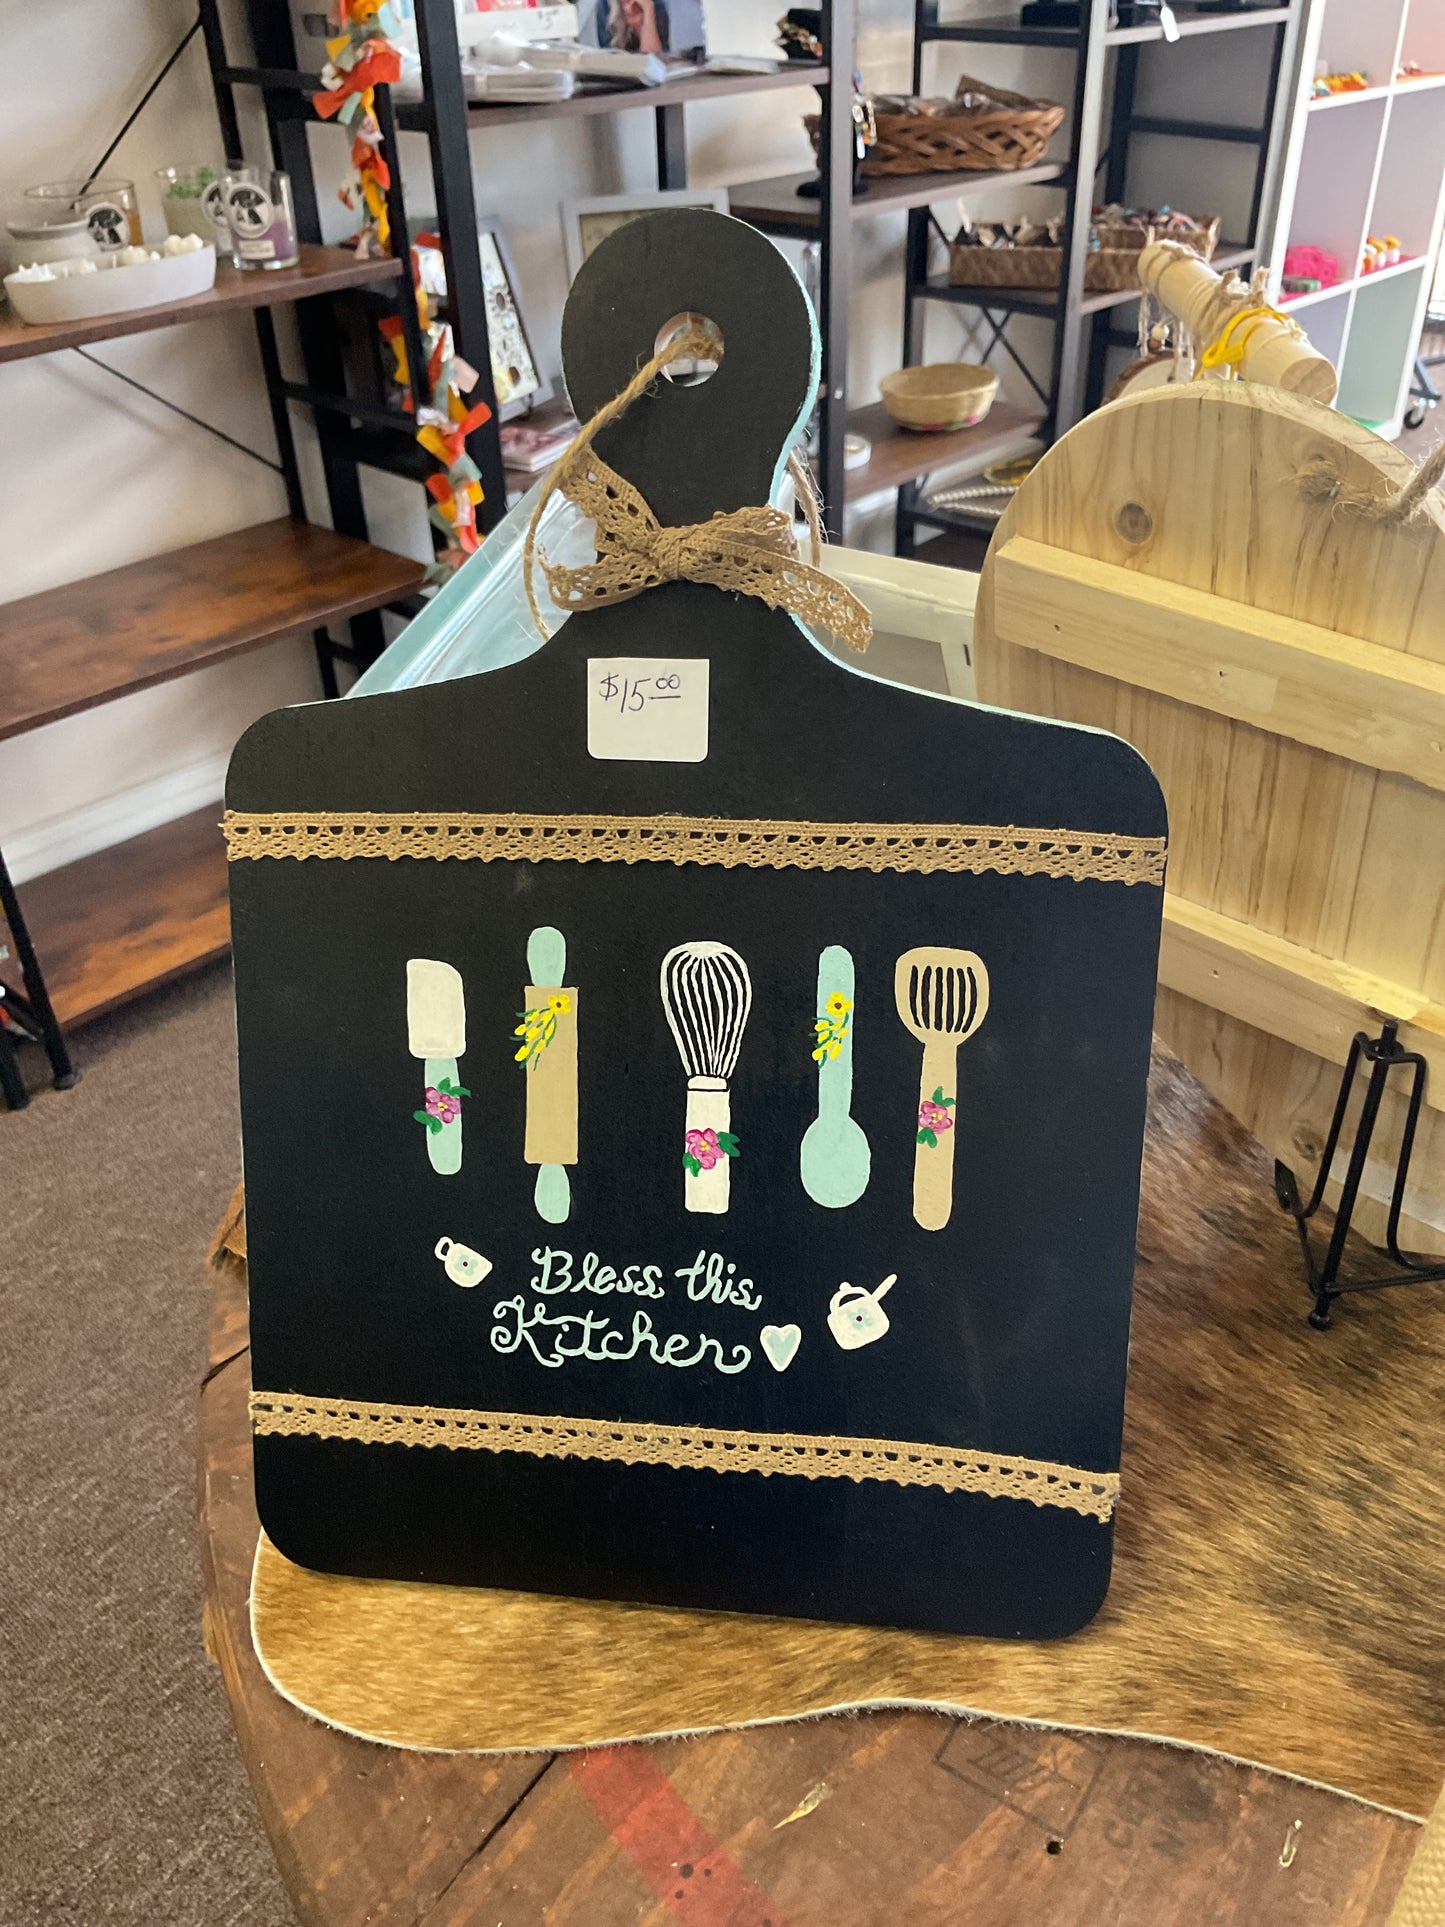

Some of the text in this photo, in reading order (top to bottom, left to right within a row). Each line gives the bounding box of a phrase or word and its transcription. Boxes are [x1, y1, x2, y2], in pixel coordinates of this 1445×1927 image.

[530, 1245, 763, 1311] Bless this
[490, 1294, 752, 1375] Kitchen
